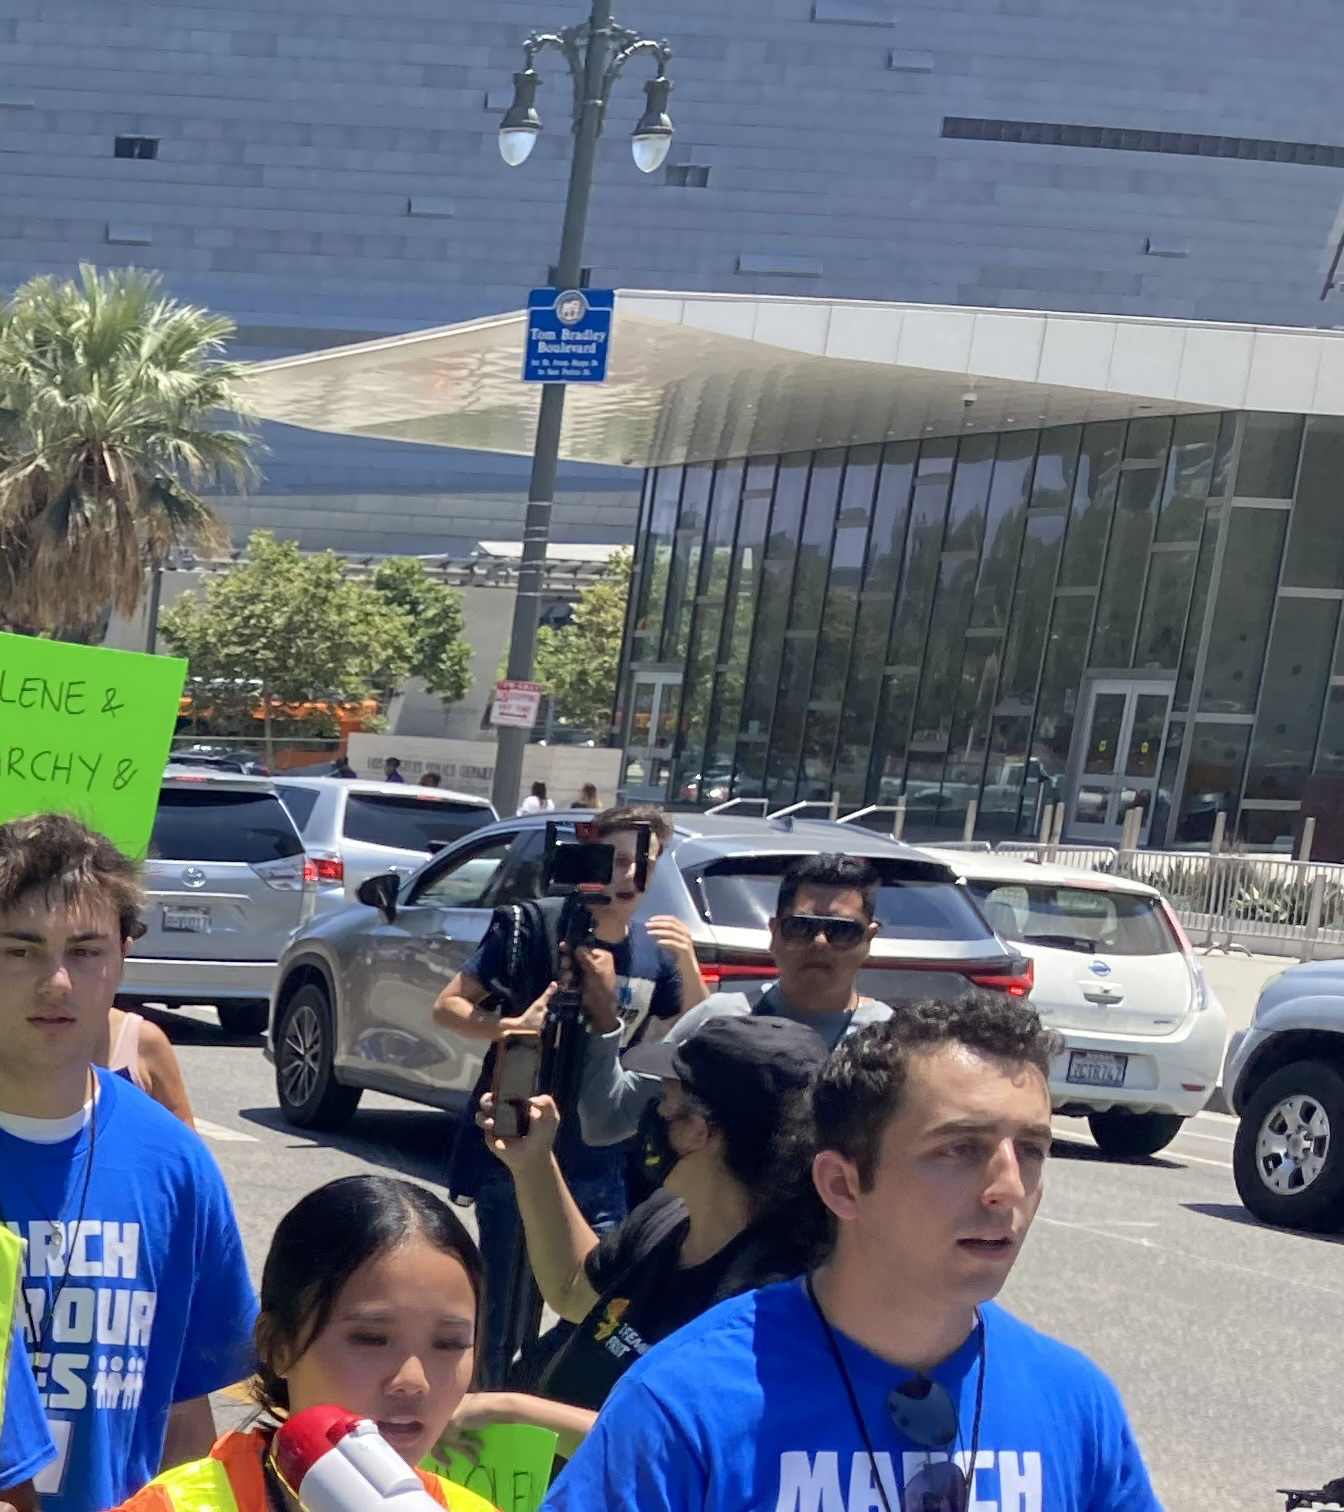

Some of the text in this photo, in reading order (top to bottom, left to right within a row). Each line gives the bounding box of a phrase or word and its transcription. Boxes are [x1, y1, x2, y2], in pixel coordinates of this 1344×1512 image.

[531, 328, 606, 343] Tom Bradley
[538, 341, 596, 353] Boulevard
[100, 688, 125, 718] &
[112, 758, 138, 791] &
[52, 1286, 157, 1346] OUR
